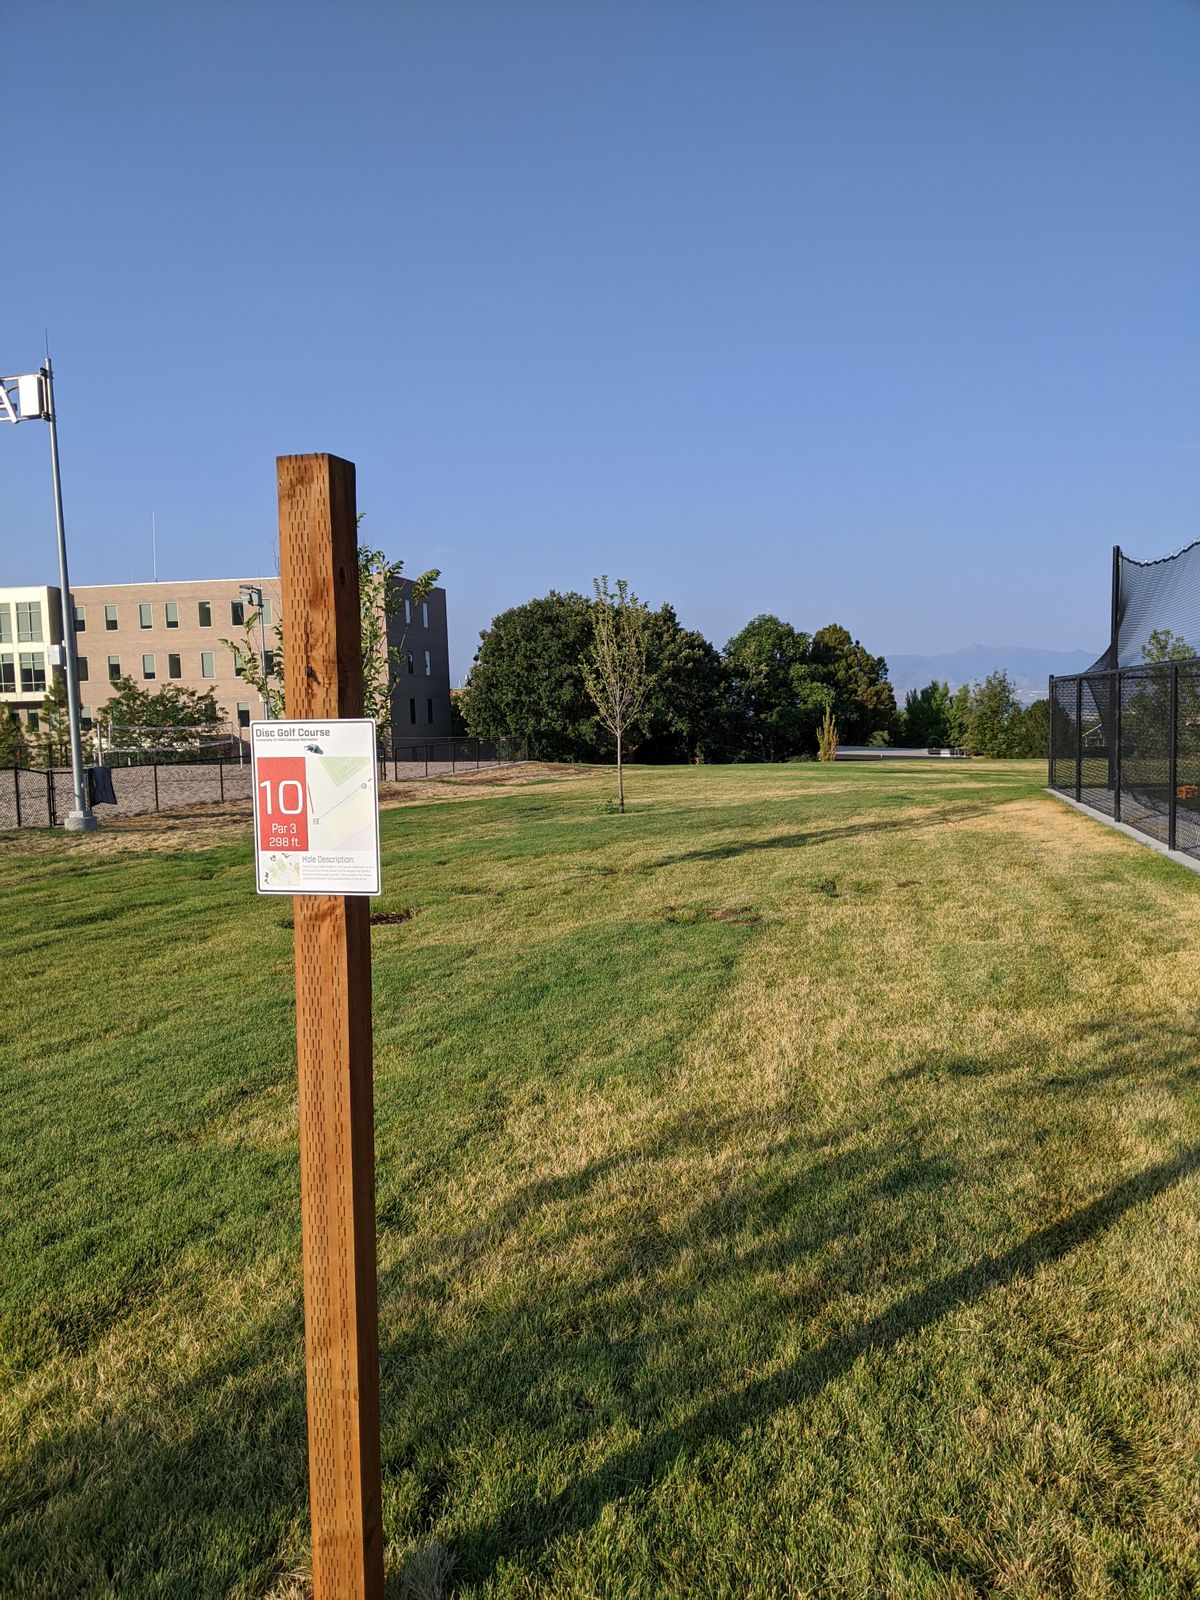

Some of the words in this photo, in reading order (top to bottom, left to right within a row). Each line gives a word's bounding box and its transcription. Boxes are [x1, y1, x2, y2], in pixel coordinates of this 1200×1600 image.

[256, 728, 275, 737] Disc
[277, 728, 296, 737] Golf
[298, 728, 330, 736] Course
[260, 780, 302, 814] 10
[272, 824, 288, 834] Par
[290, 824, 296, 834] 3
[270, 838, 288, 846] 298
[292, 838, 301, 846] ft.
[318, 856, 355, 864] Description:
